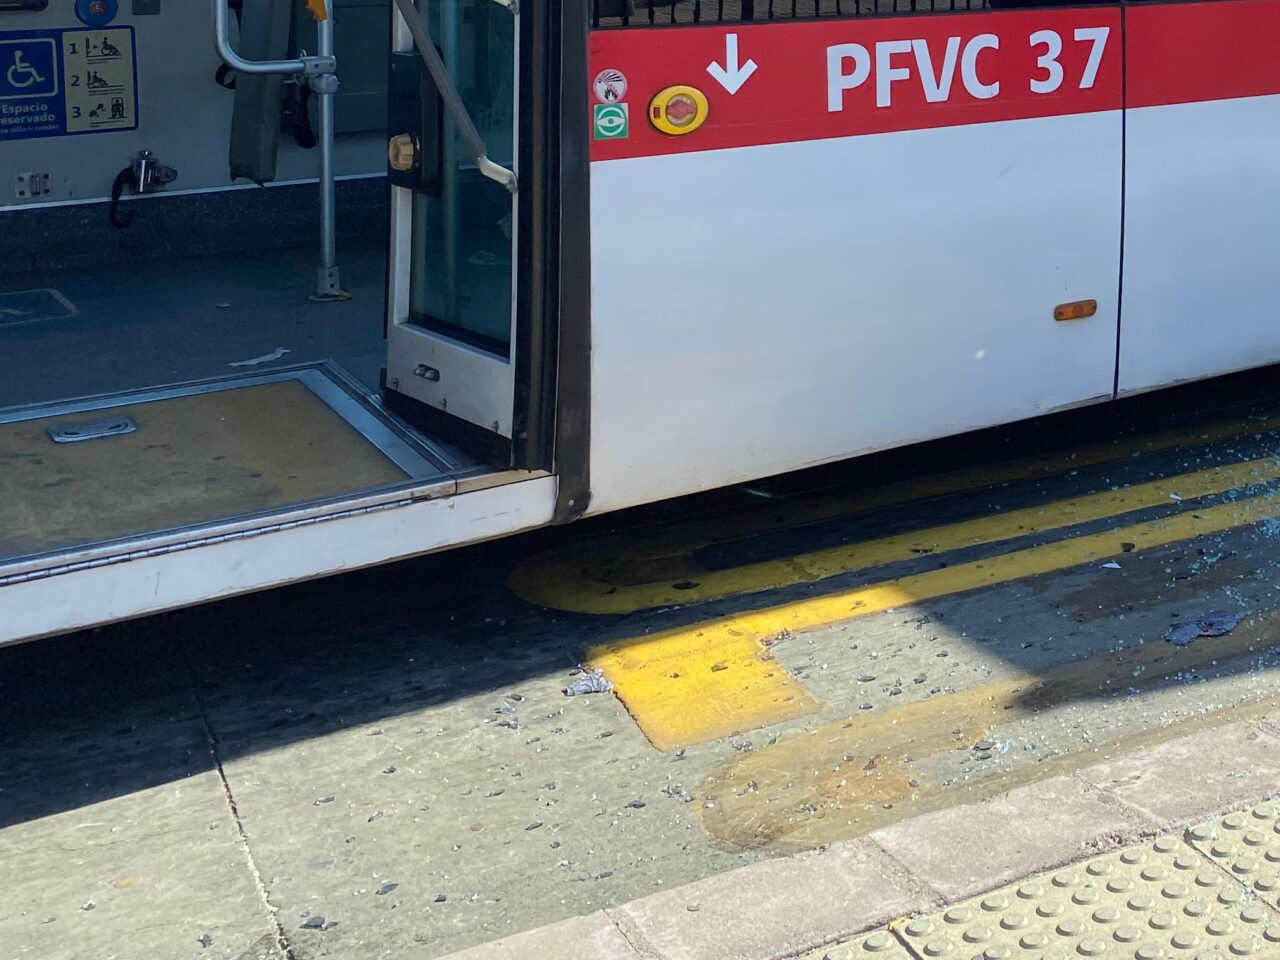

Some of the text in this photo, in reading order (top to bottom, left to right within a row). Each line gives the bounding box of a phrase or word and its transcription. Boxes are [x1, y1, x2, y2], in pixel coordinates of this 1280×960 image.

[69, 42, 78, 55] 1
[826, 26, 1110, 112] PFVC 37
[71, 74, 80, 86] 2
[2, 101, 48, 116] Espacio
[71, 106, 81, 118] 3
[0, 112, 55, 125] eservado
